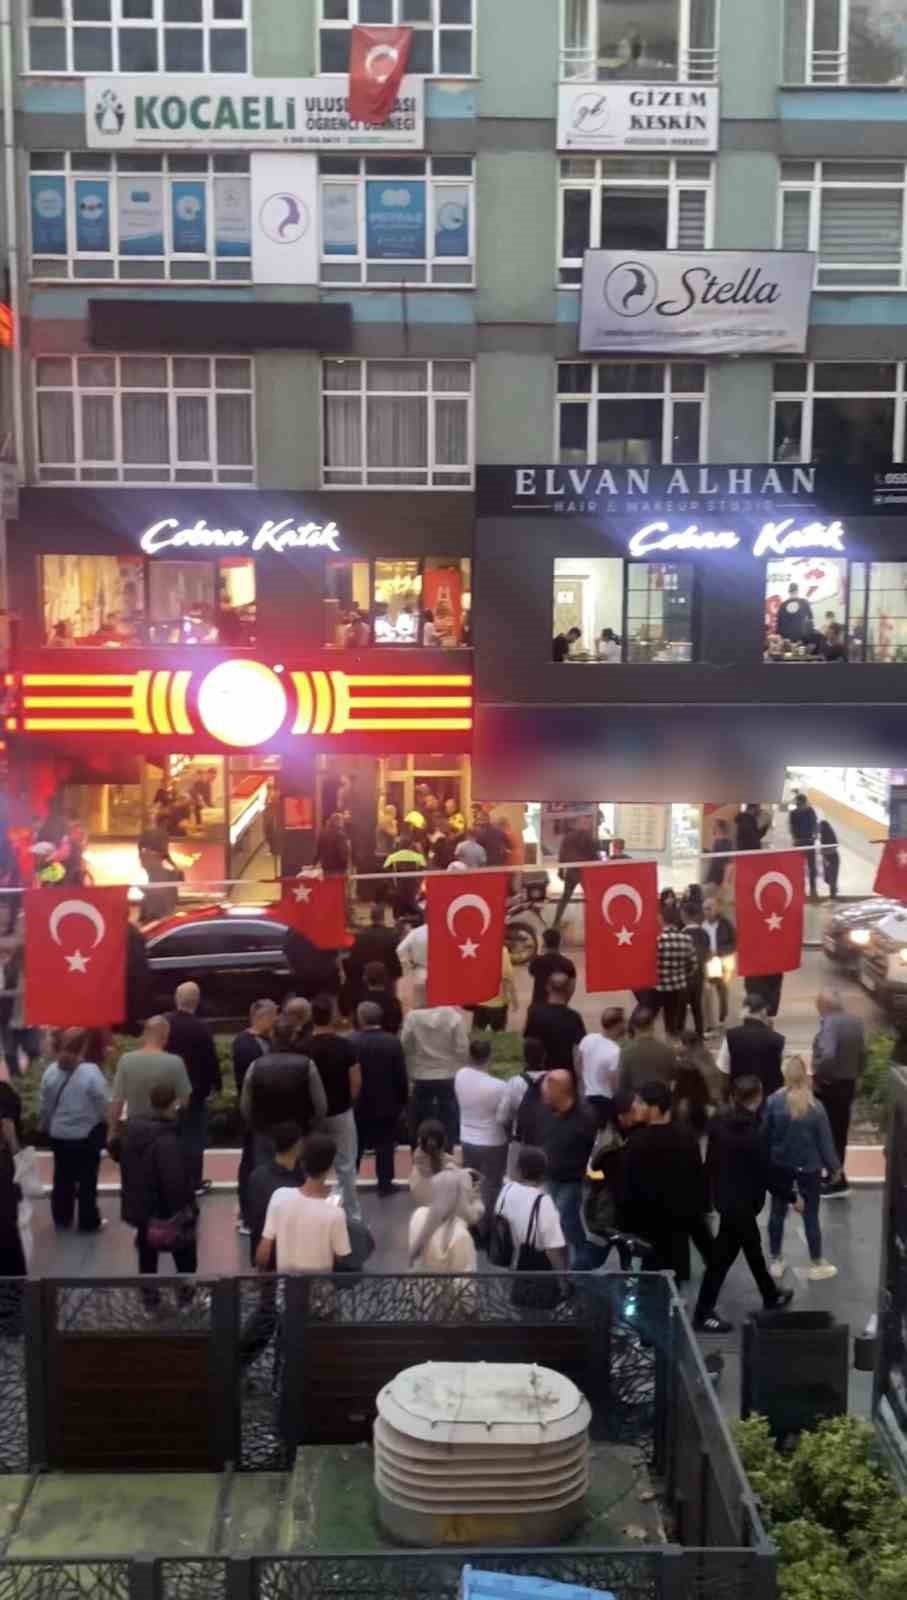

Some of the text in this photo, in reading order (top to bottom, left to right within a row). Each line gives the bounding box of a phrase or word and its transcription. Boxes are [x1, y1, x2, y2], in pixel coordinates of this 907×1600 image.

[629, 89, 706, 107] GİZEM
[134, 95, 295, 130] KOCAELİ
[628, 112, 706, 130] KESKİN
[656, 267, 781, 316] Stella
[515, 468, 817, 495] ELVAN ALHAN
[554, 501, 597, 513] HAIR
